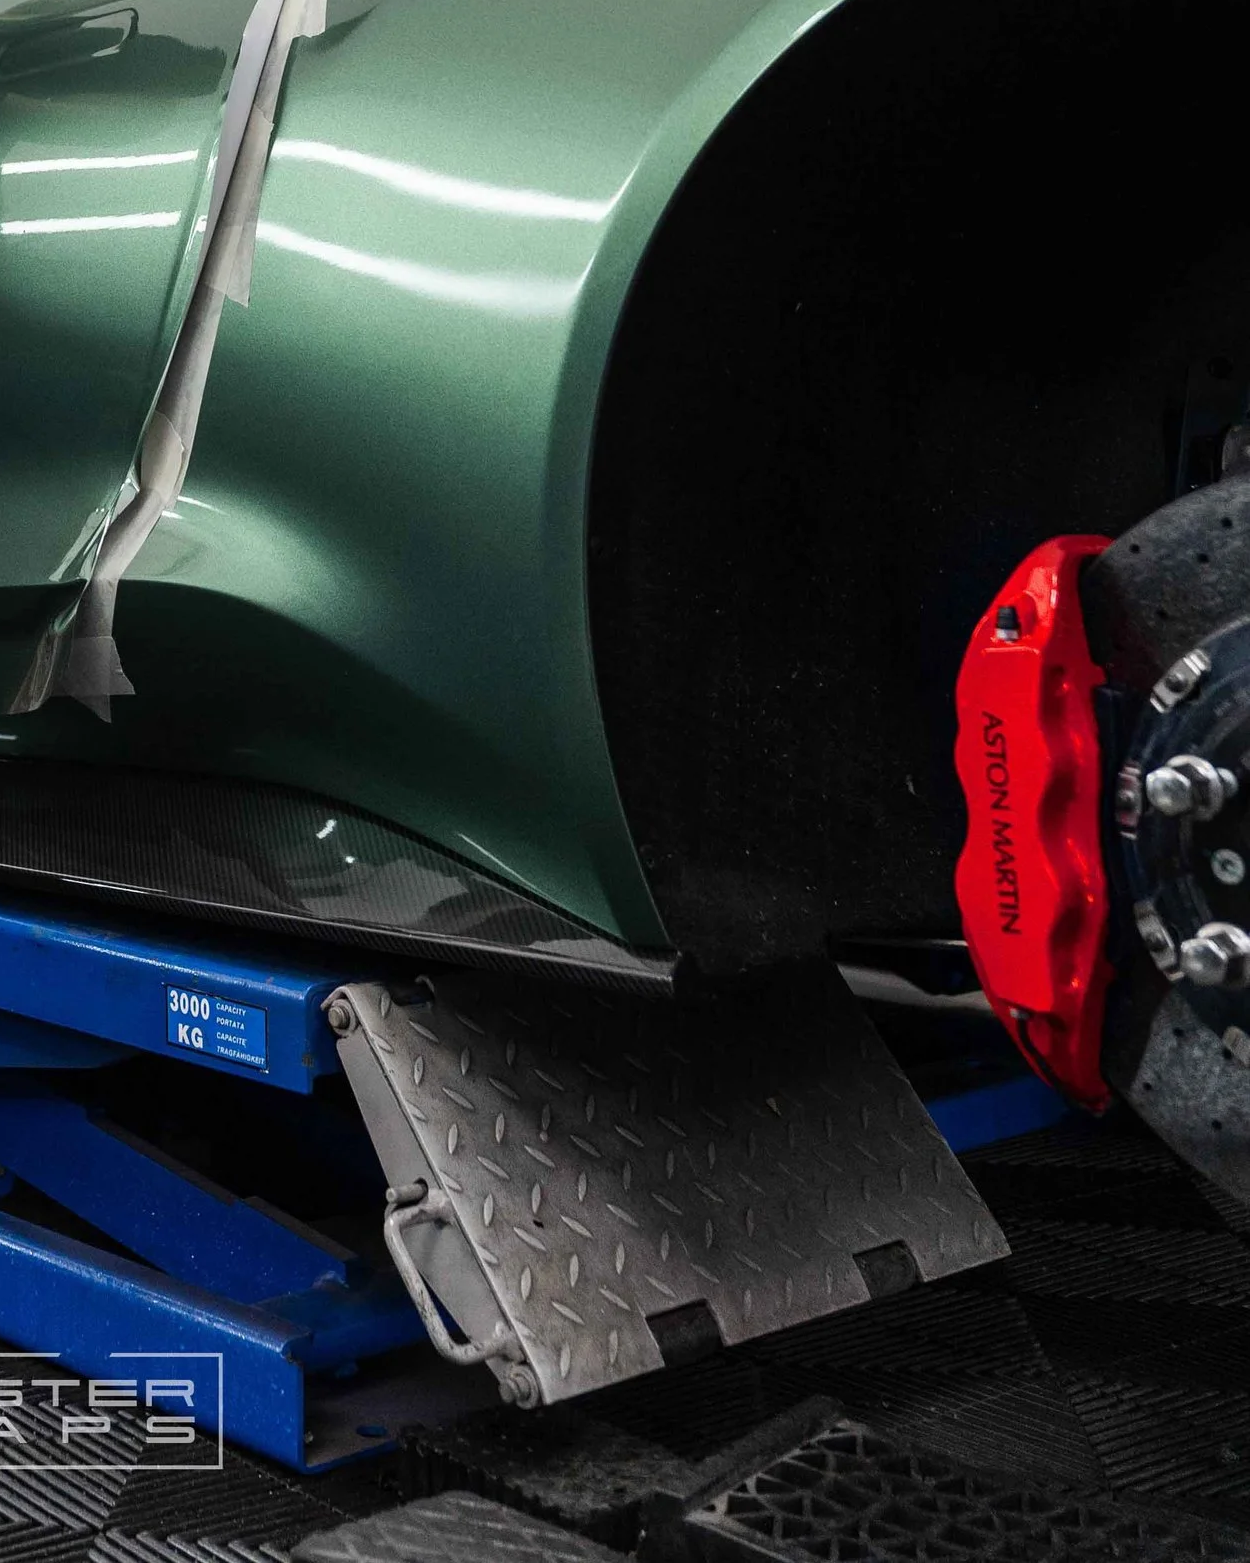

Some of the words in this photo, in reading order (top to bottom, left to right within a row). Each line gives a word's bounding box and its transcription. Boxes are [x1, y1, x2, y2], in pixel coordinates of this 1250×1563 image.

[981, 711, 1011, 812] ASTON
[992, 819, 1022, 935] MARTIN
[170, 990, 210, 1020] 3000
[216, 1002, 247, 1017] CAPACITY
[178, 1023, 204, 1049] KG
[216, 1017, 245, 1030] PORTATA
